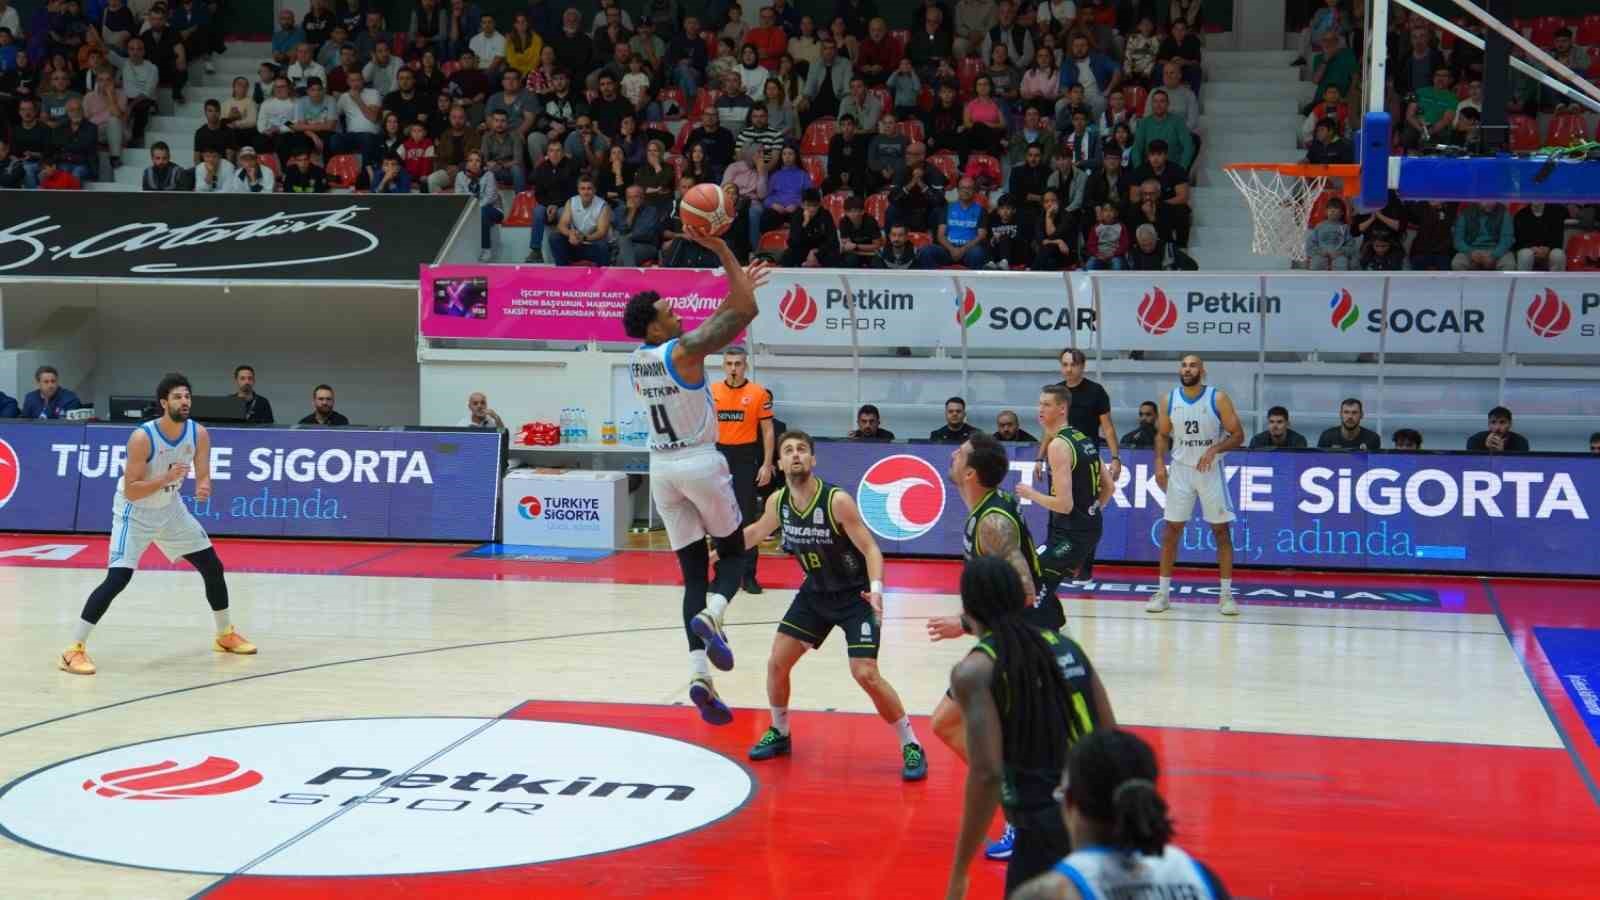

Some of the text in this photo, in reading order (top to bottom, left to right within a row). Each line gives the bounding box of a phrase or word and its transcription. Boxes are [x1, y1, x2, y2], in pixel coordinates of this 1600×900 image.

[825, 288, 914, 312] Petkim
[1185, 291, 1281, 314] Petkim
[825, 318, 886, 330] SPOR
[989, 306, 1098, 332] SOCAR
[1185, 321, 1252, 335] SPOR
[1367, 308, 1485, 333] SOCAR
[650, 404, 679, 442] 4
[1184, 420, 1200, 435] 23
[231, 487, 348, 520] adında.
[303, 765, 695, 802] Petkim
[267, 792, 545, 816] SPOR
